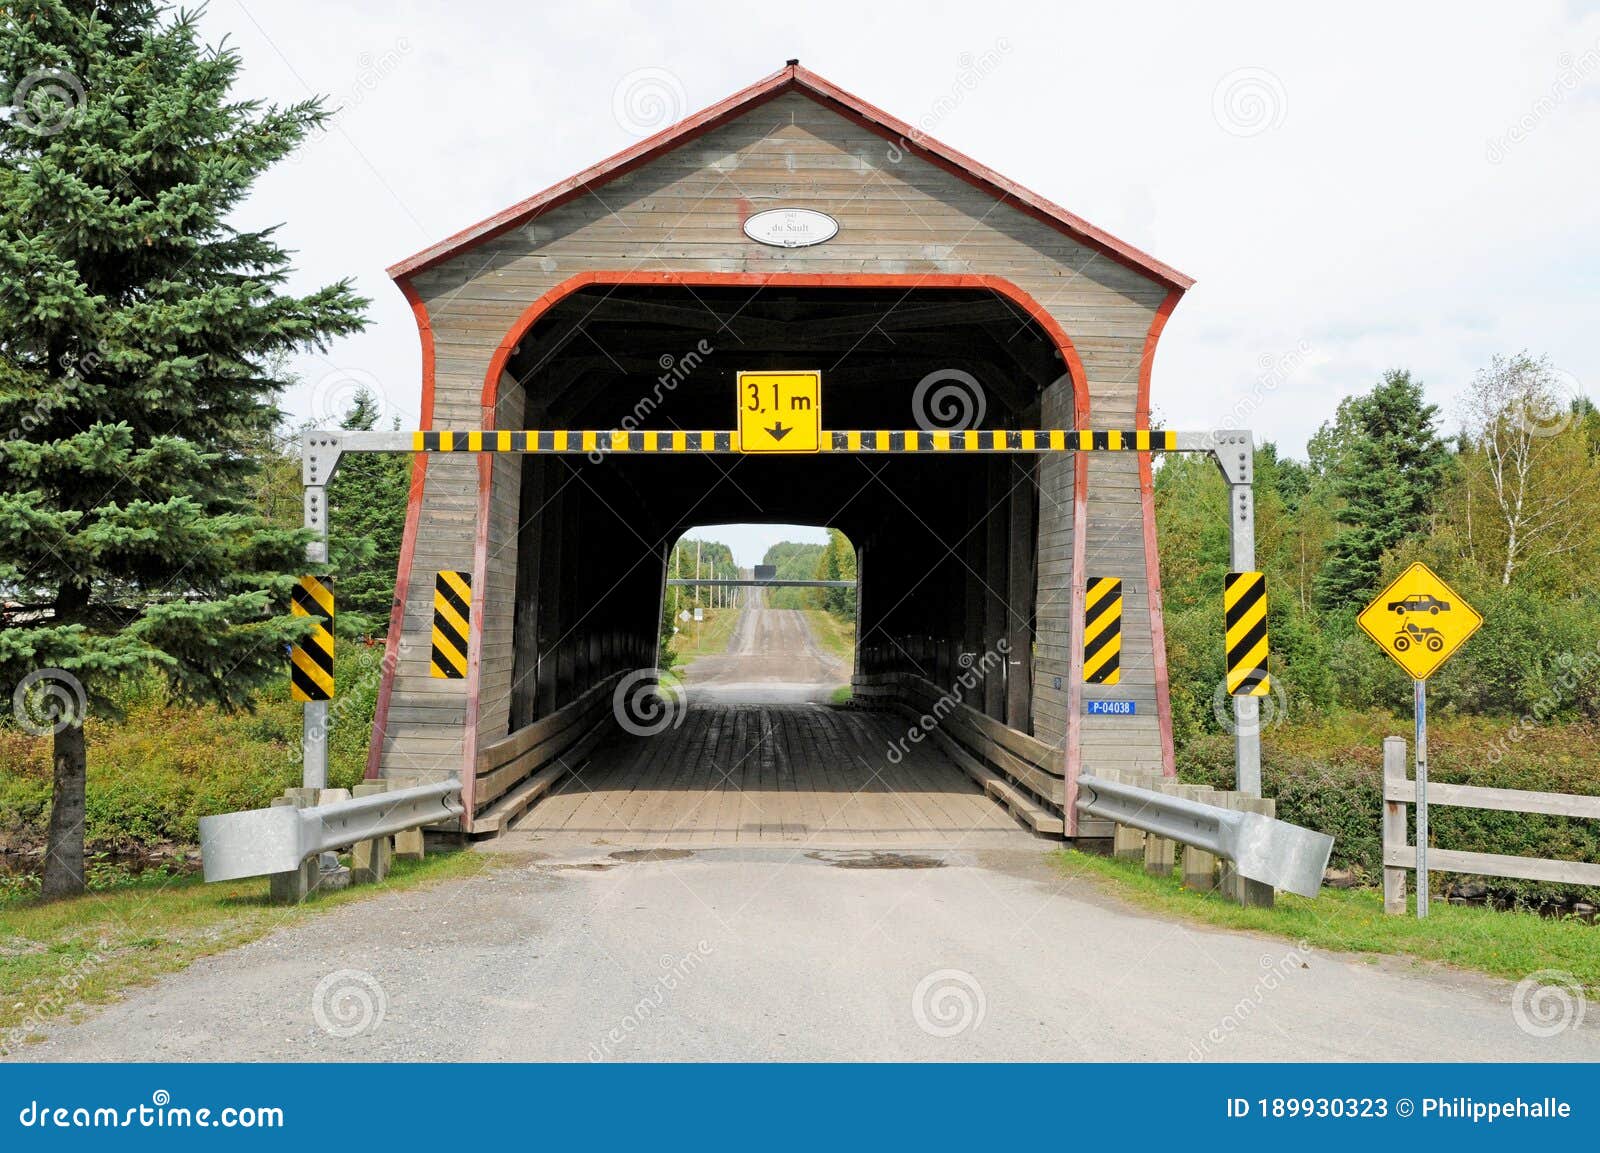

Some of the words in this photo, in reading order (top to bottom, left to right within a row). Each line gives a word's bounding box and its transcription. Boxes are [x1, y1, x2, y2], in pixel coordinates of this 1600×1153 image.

[772, 224, 783, 232] du
[786, 223, 809, 232] Sault
[748, 383, 779, 413] 3,1
[791, 396, 811, 411] m
[1093, 701, 1130, 714] P-04038
